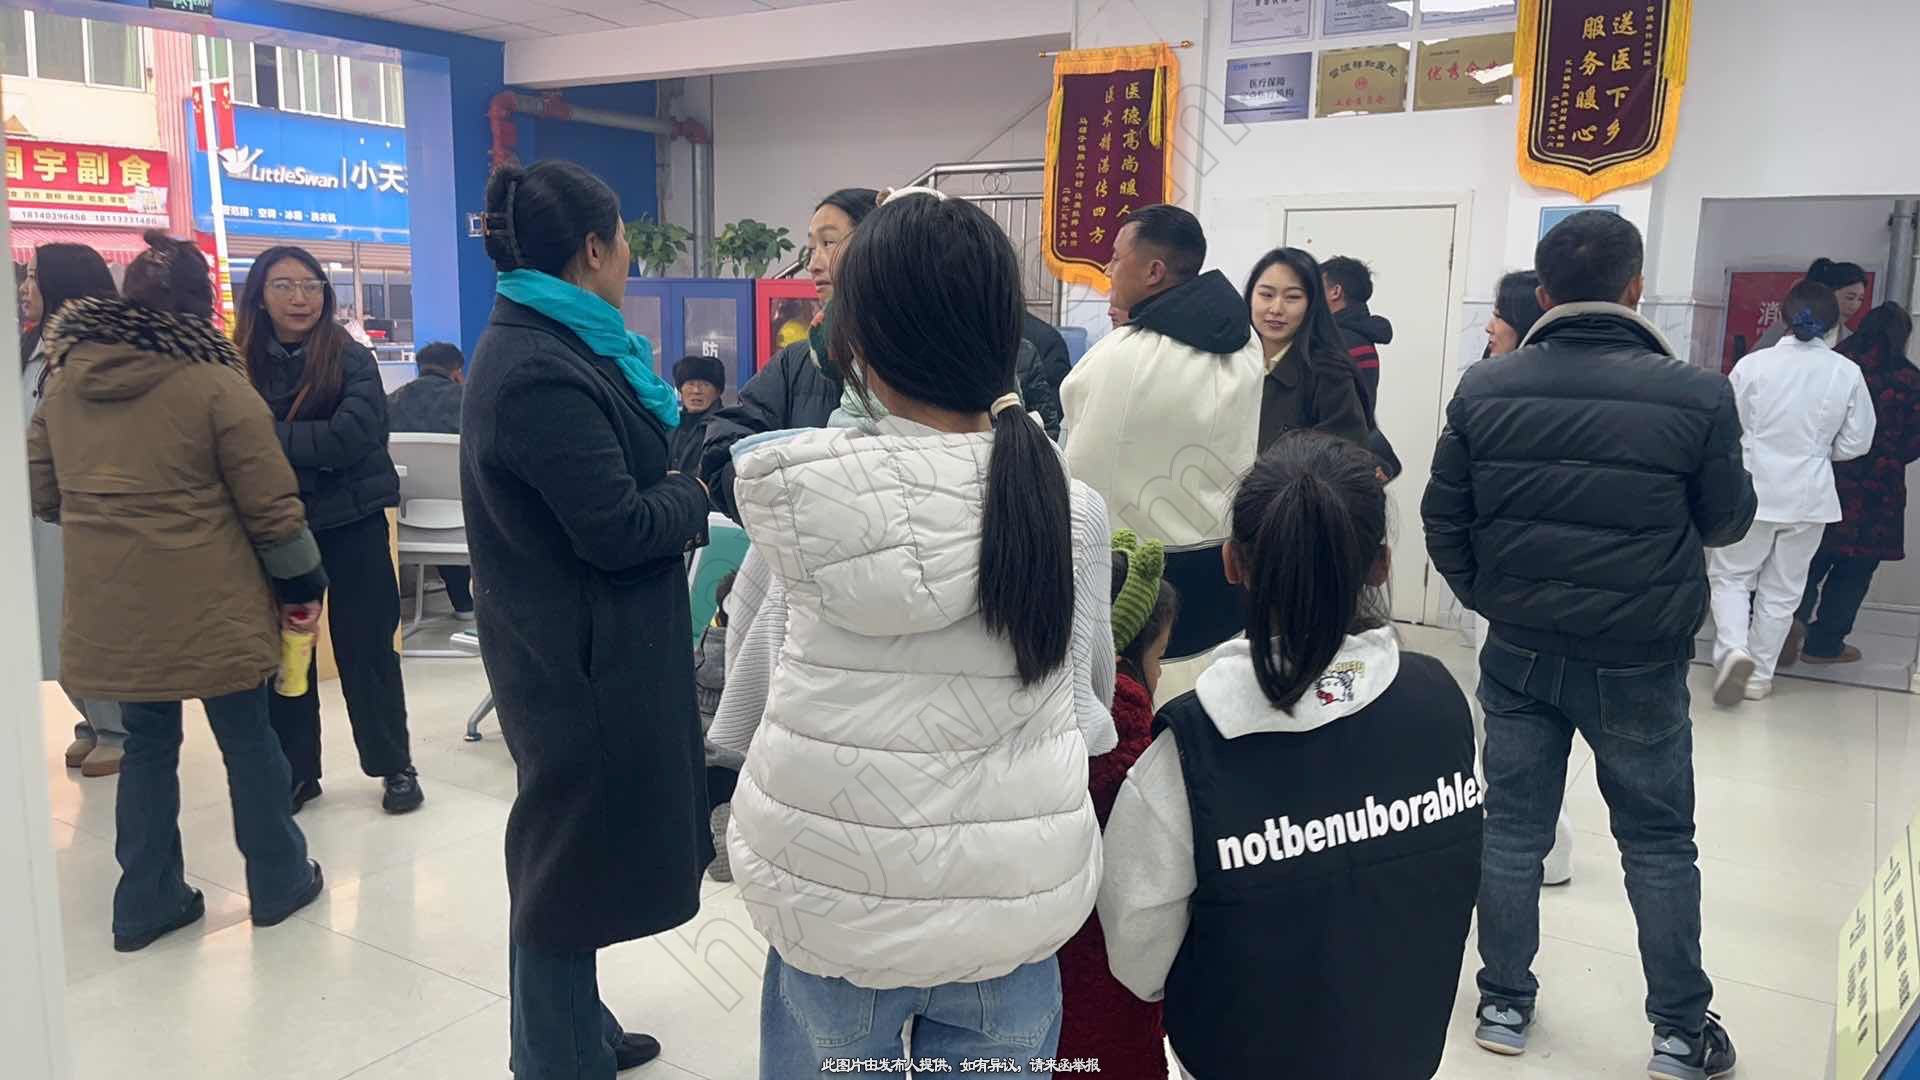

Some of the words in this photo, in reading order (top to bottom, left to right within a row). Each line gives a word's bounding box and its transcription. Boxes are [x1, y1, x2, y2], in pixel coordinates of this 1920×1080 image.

[1572, 16, 1607, 142] 服务暖心
[1602, 10, 1638, 146] 送医下乡
[6, 145, 152, 188] 国宇副食
[251, 164, 339, 189] LittleSwan
[350, 159, 409, 194] 小天
[702, 340, 719, 359] 防
